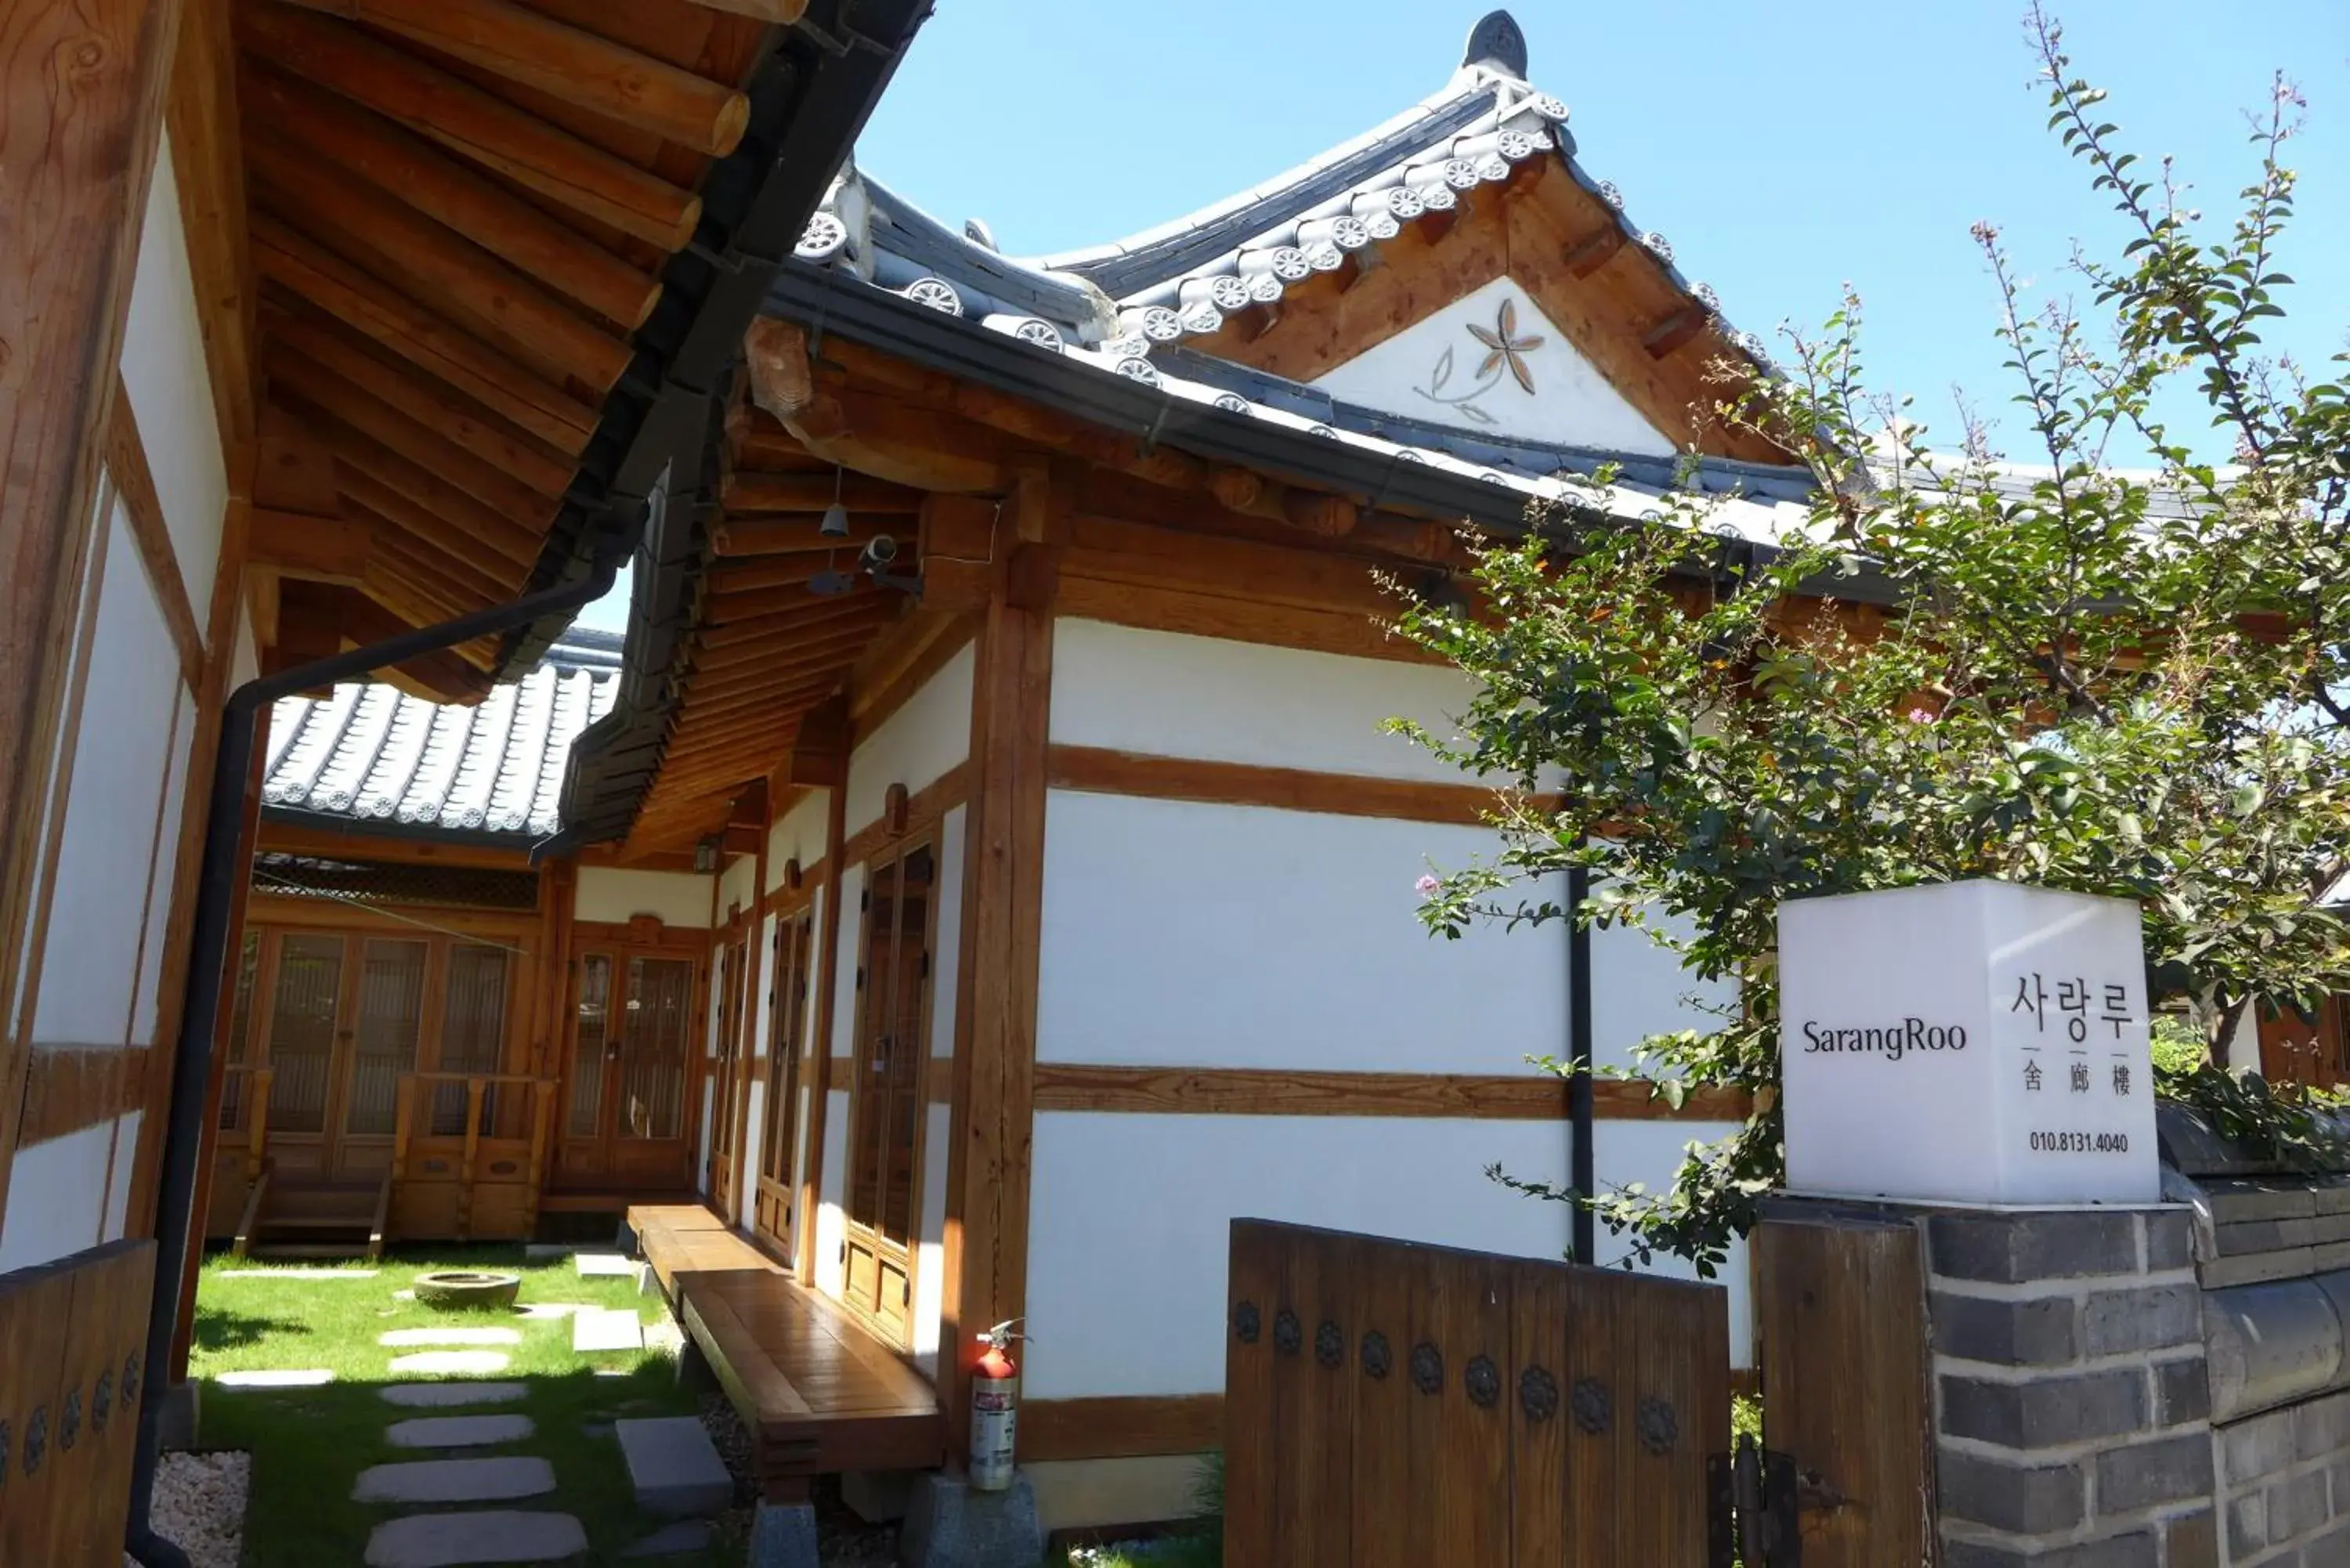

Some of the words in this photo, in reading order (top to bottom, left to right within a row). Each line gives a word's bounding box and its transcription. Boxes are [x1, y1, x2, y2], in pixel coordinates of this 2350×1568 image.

[2011, 972, 2133, 1044] 사랑루
[1802, 1017, 1968, 1061] SarangRoo
[2030, 1131, 2129, 1154] 010.8131.4040
